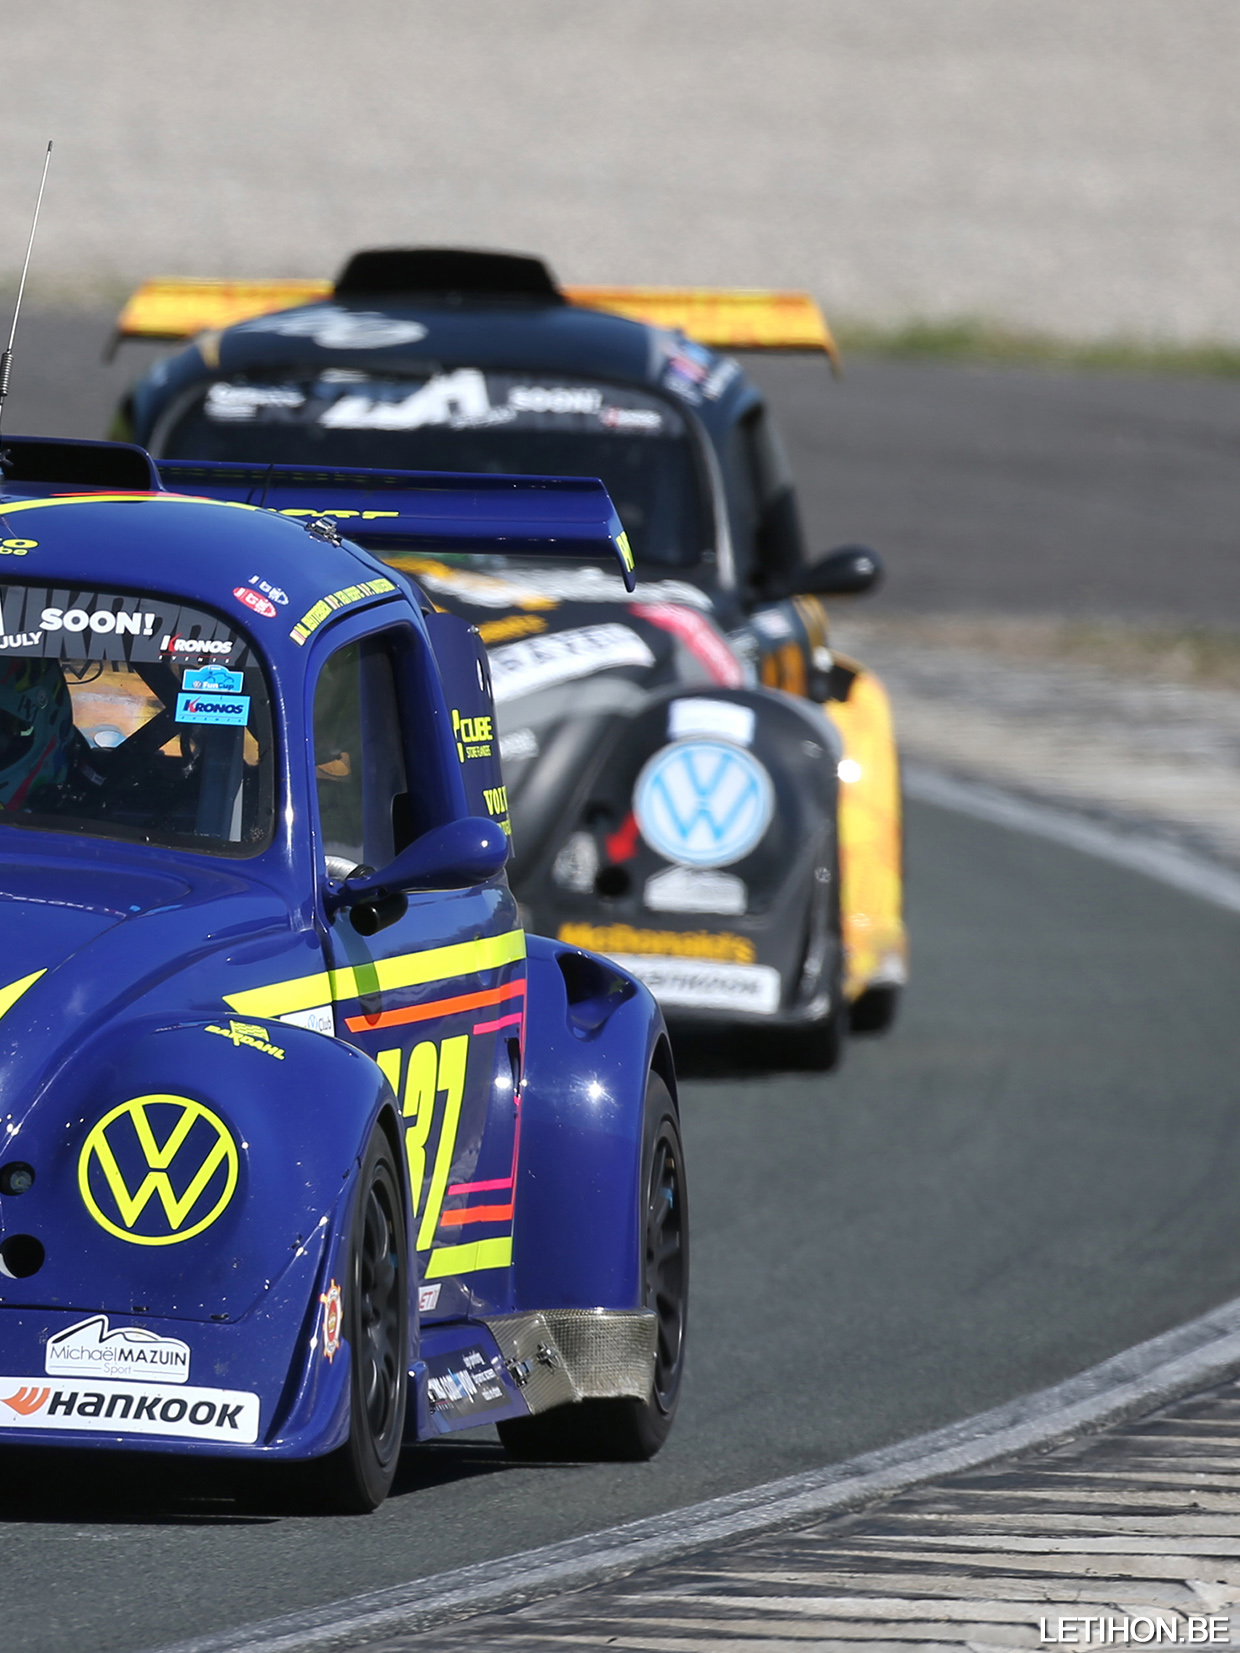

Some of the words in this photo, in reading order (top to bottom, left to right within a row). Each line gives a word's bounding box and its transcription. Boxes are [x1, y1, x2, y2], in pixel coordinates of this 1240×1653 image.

[39, 607, 156, 636] SOON!
[0, 632, 43, 650] JULY
[160, 632, 233, 654] KRONOS
[202, 681, 235, 691] FunCup
[183, 696, 244, 714] KRONOS
[459, 716, 494, 743] CUBE
[203, 1024, 286, 1061] BARDAHL
[102, 1362, 132, 1376] Sport
